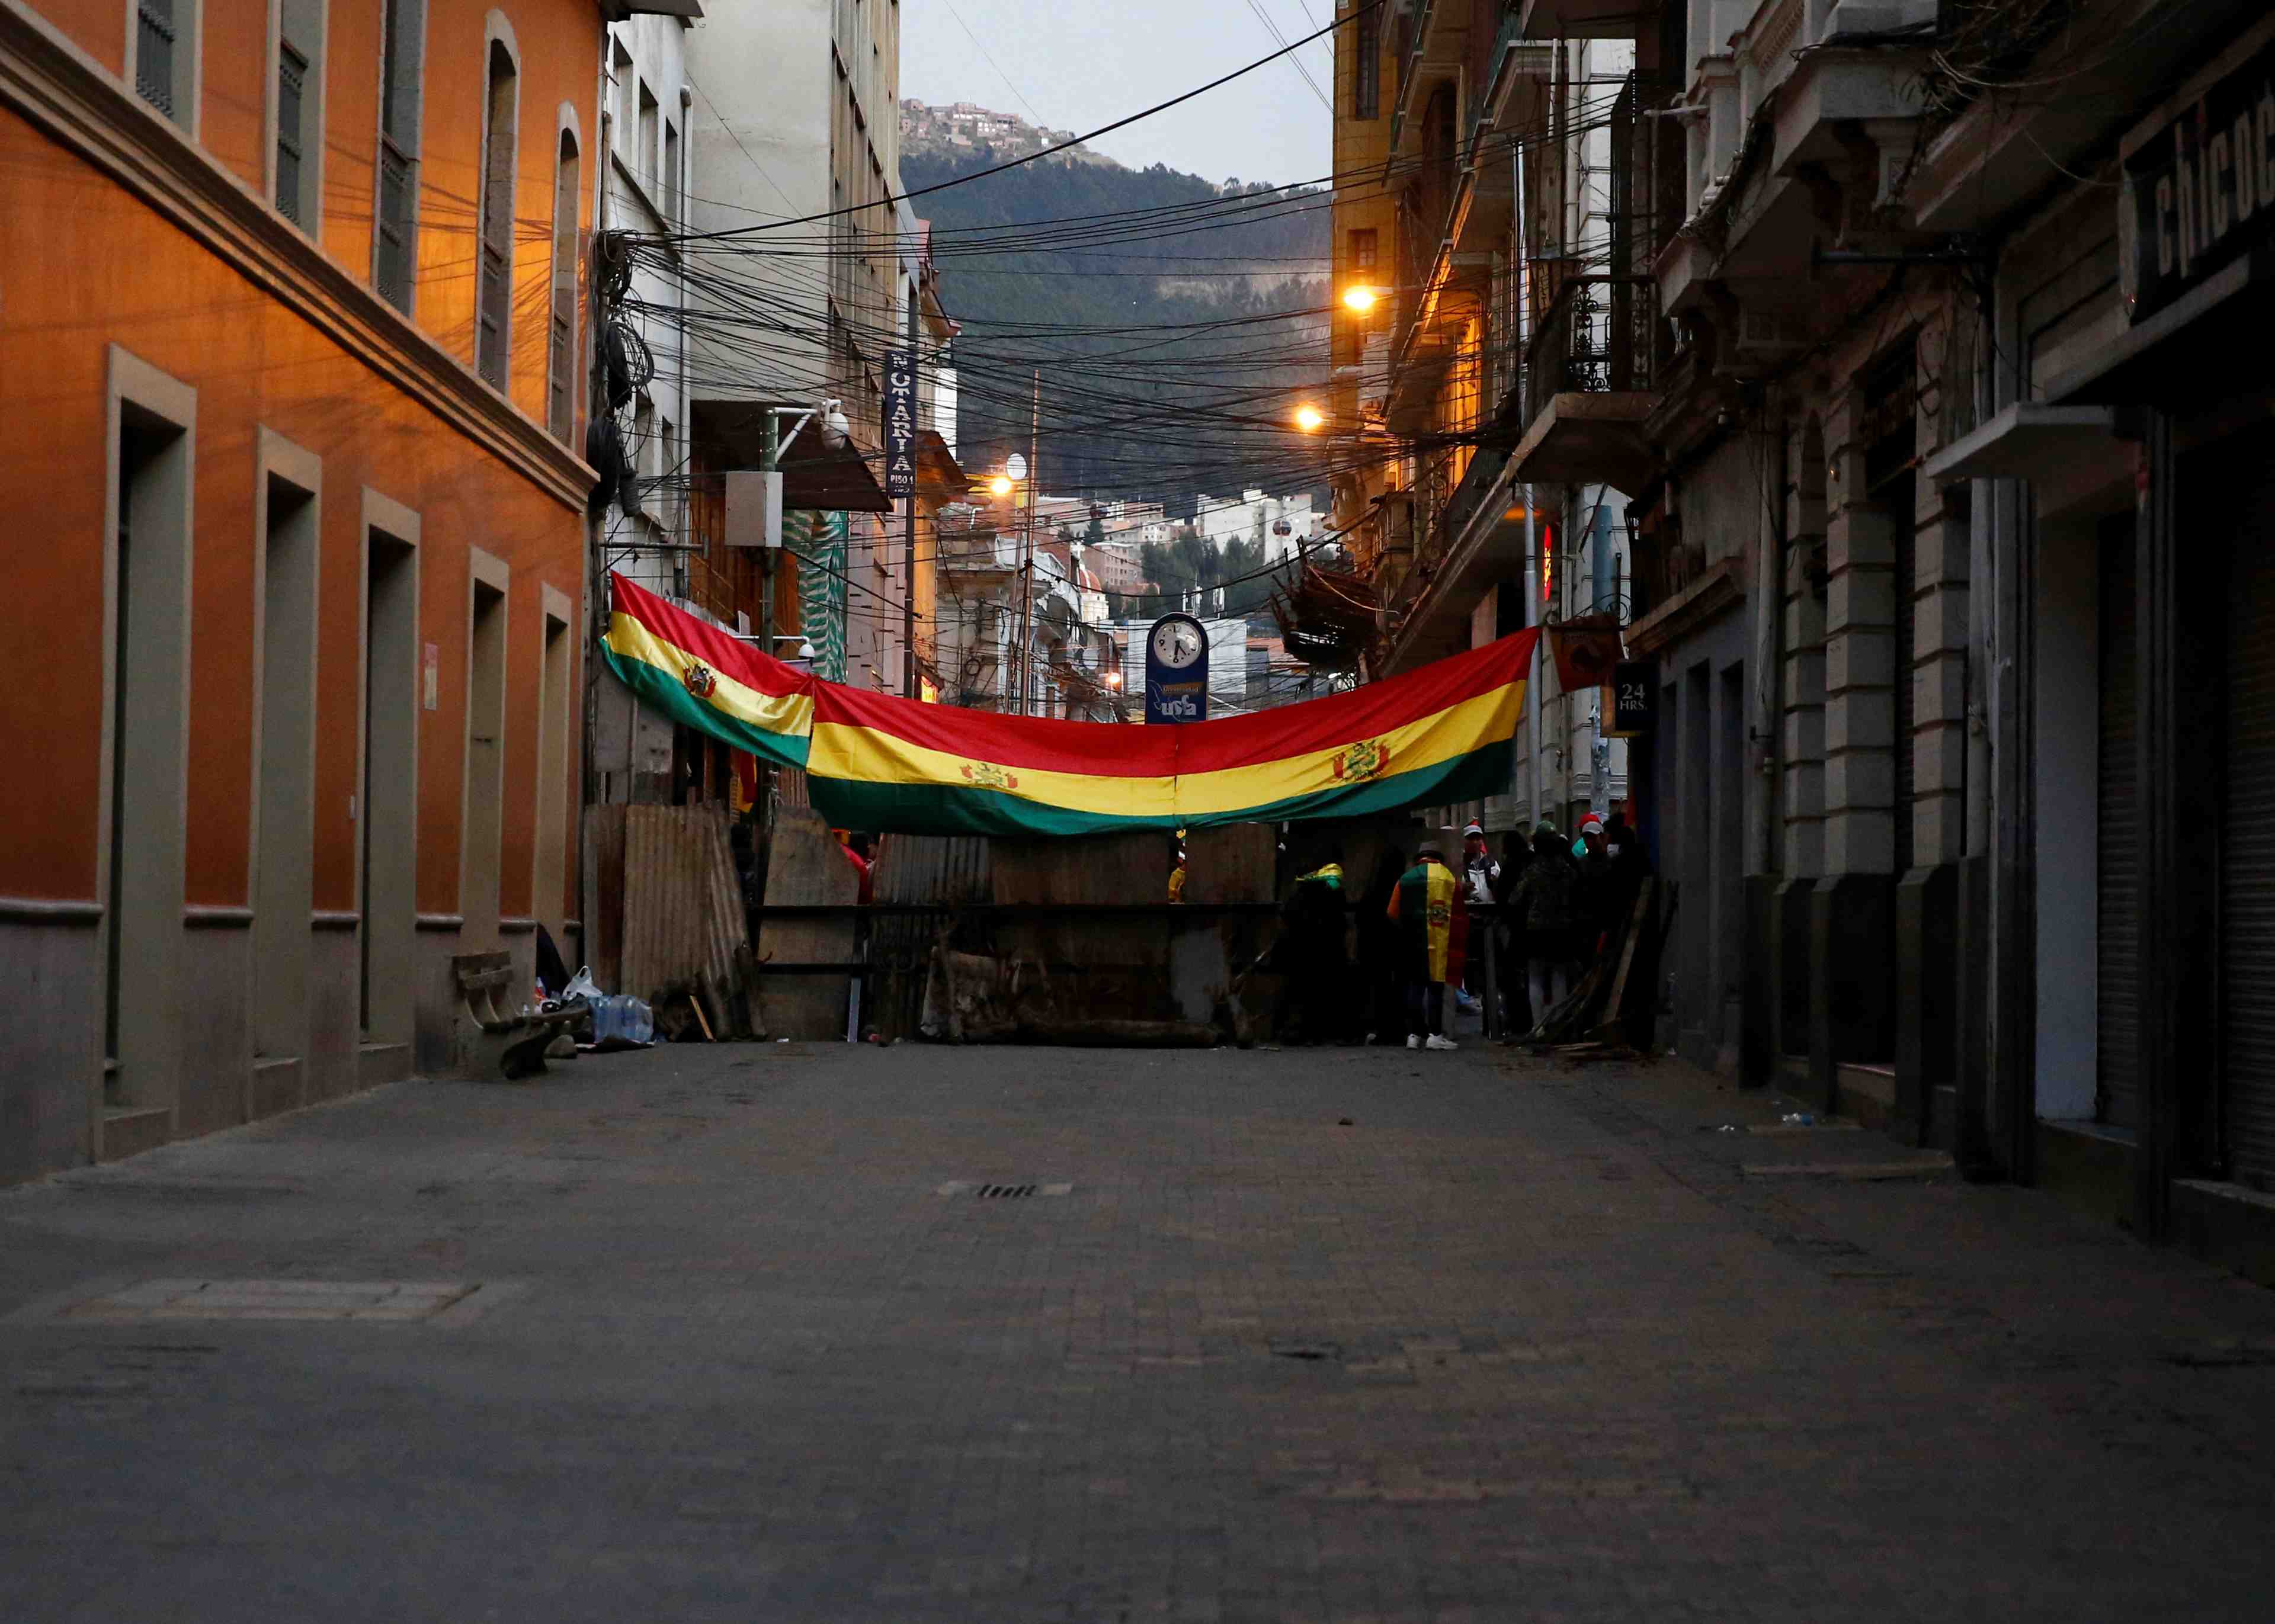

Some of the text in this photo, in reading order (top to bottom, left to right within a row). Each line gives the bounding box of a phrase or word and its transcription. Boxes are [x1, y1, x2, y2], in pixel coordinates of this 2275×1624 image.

[890, 354, 912, 471] NOTARIA
[890, 474, 913, 484] PISO 1
[1173, 655, 1179, 663] 6
[1622, 683, 1645, 699] 24
[1620, 700, 1648, 711] HRS.
